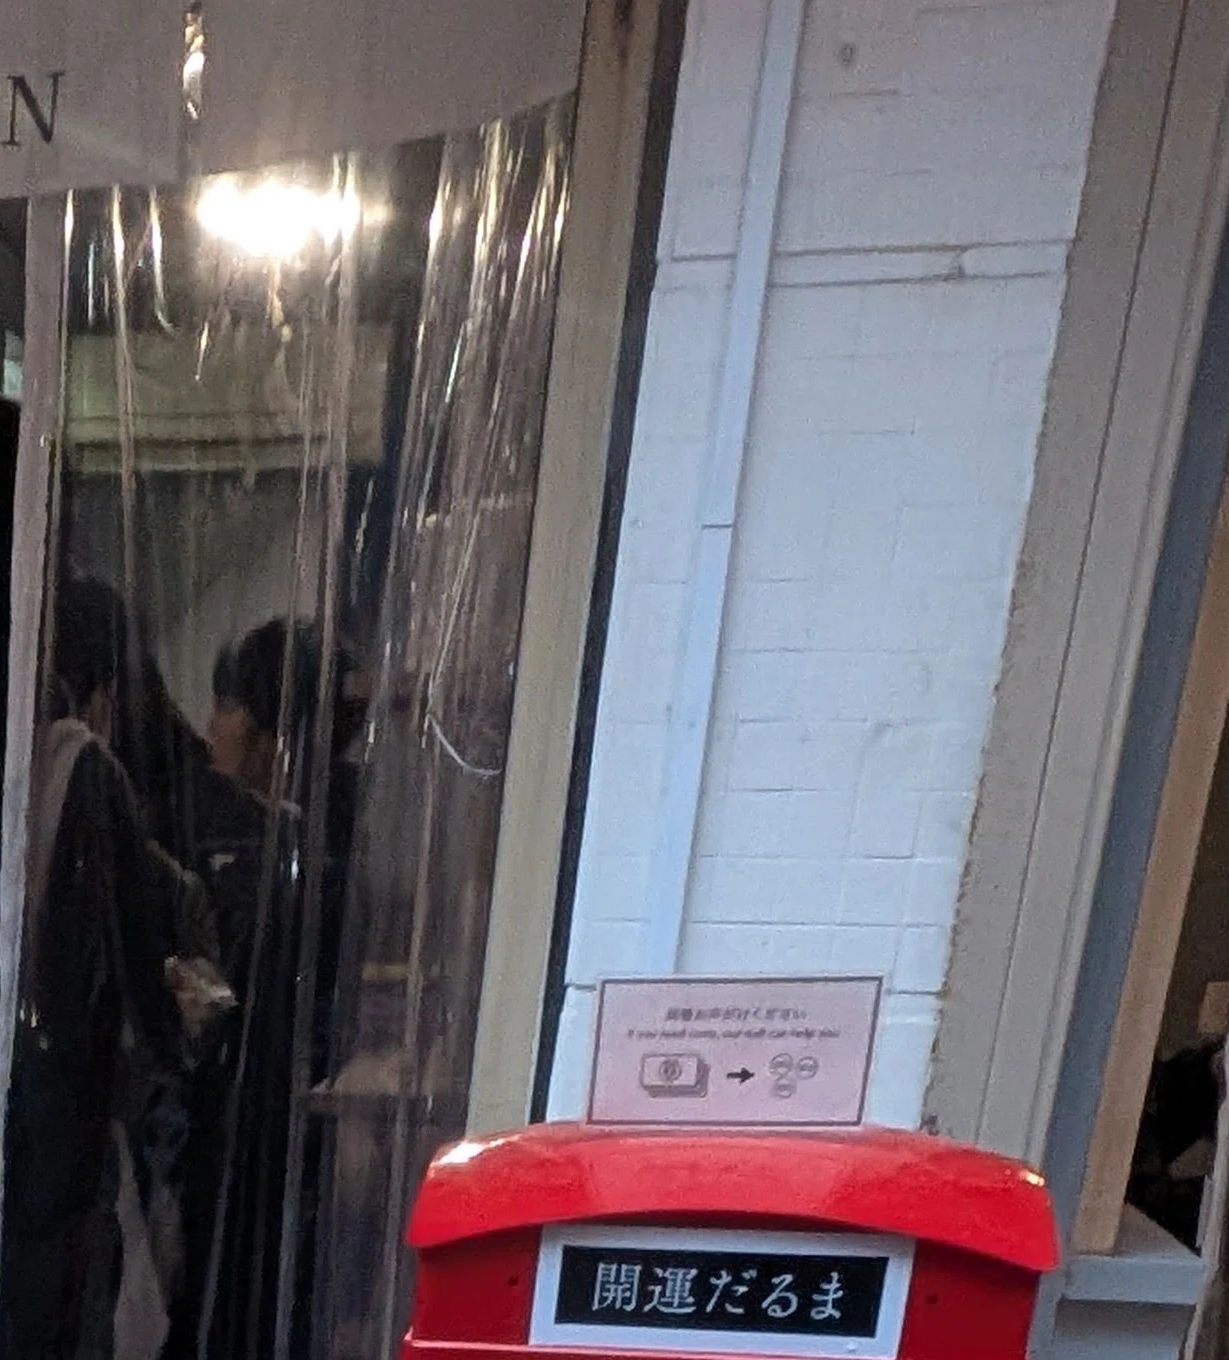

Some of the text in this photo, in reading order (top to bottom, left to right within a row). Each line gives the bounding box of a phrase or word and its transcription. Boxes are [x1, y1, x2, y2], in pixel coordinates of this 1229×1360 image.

[591, 1261, 845, 1321] 開運だるま
